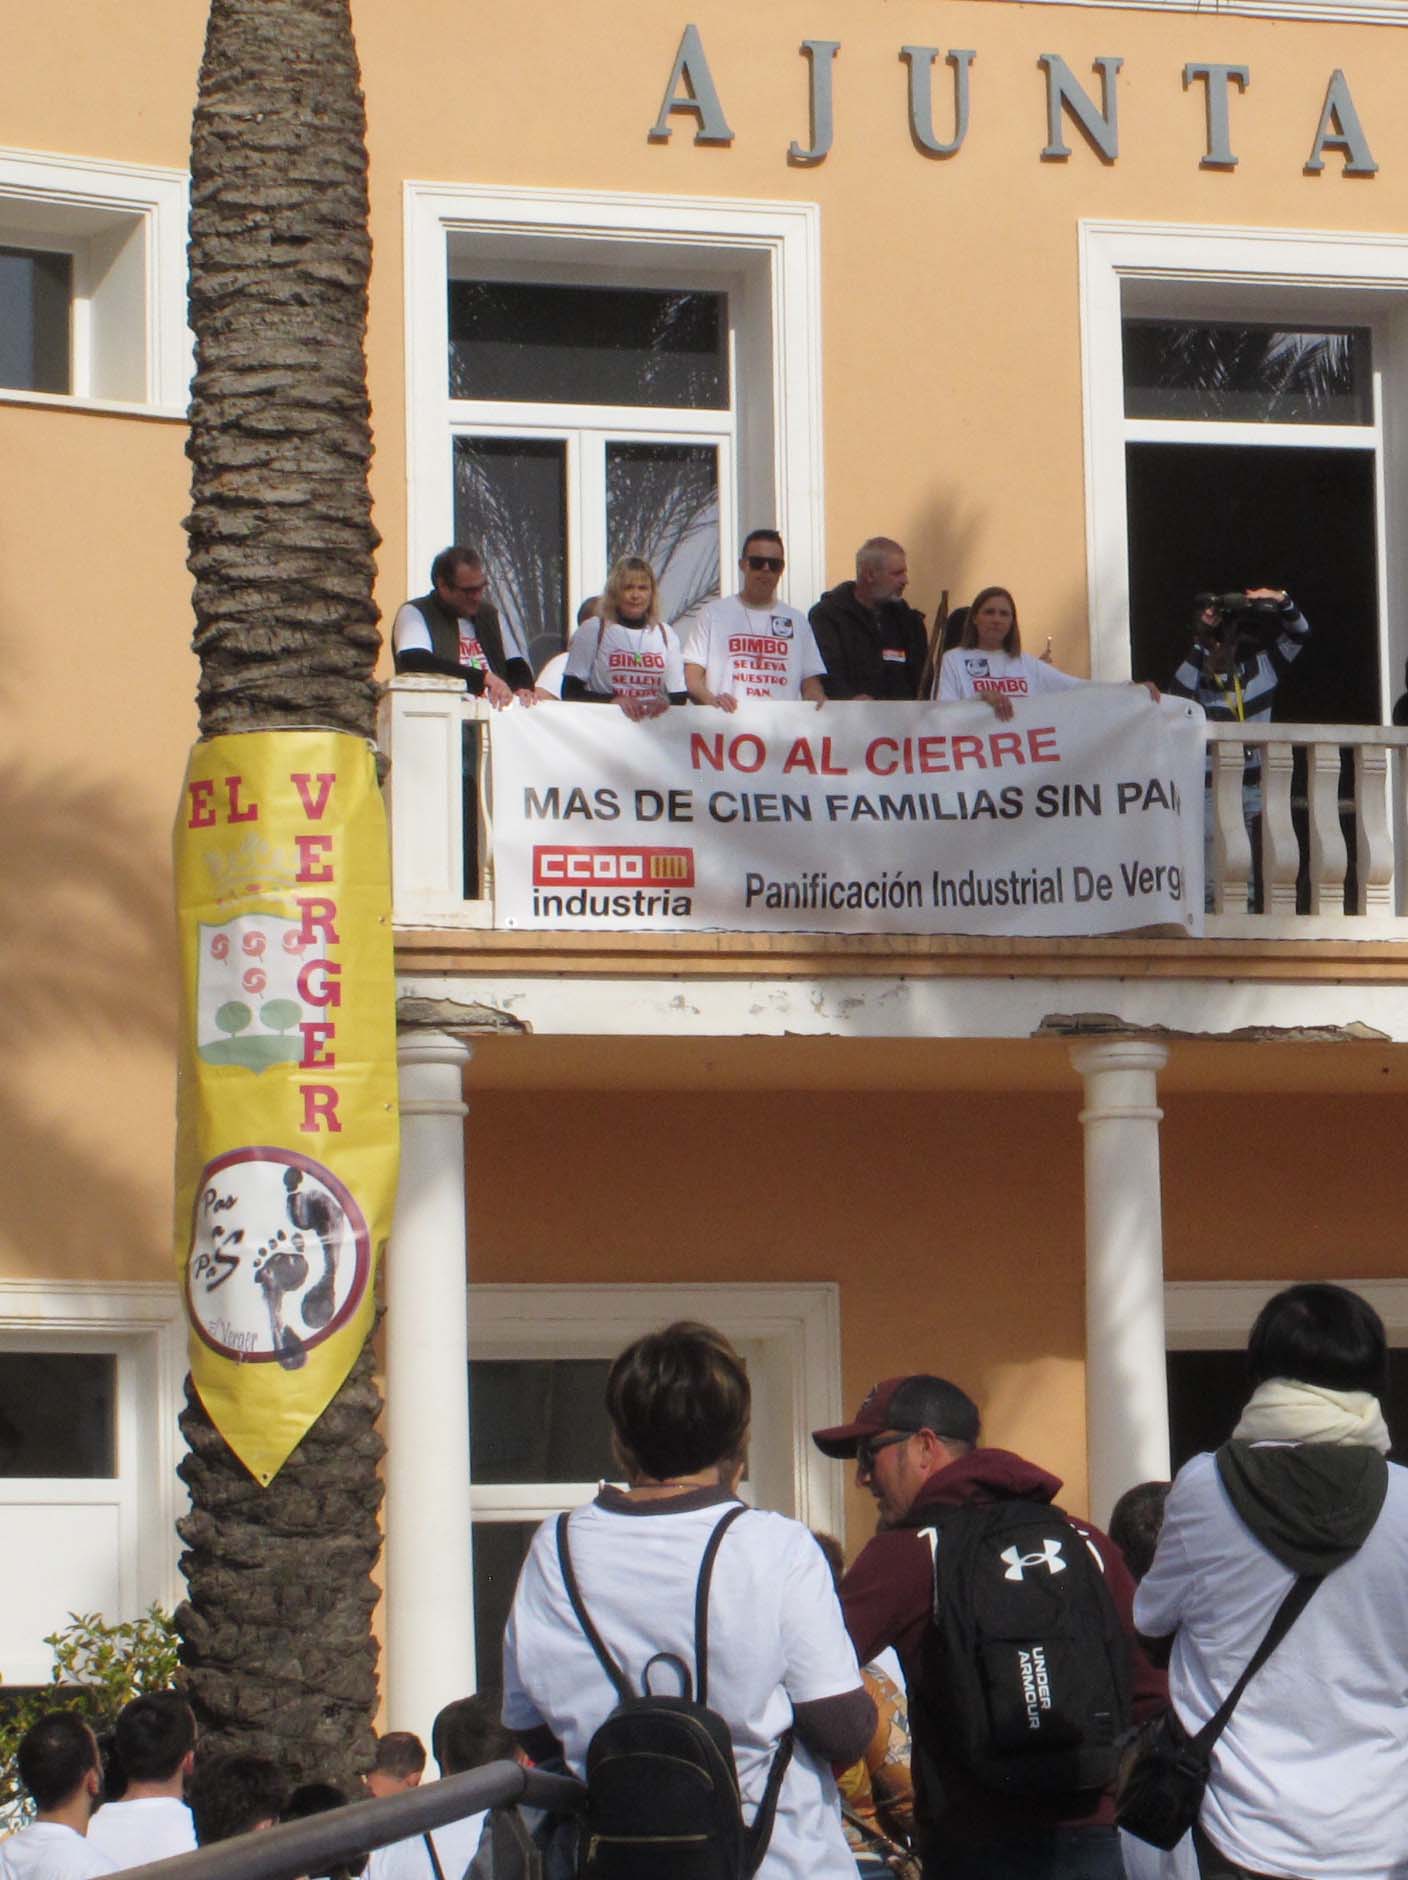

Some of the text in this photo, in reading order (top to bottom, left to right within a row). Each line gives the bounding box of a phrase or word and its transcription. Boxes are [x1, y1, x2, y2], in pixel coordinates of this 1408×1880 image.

[728, 638, 788, 656] BIMBO
[973, 679, 1028, 694] BIMBO
[690, 726, 1061, 777] NO AL CIERRE
[523, 787, 621, 821] MAS
[634, 789, 694, 822] DE
[708, 791, 811, 823] CIEN
[826, 786, 1024, 822] FAMILIAS
[1035, 783, 1102, 817] SIN
[540, 854, 644, 879] CCOO
[744, 860, 1183, 911] Panificación Industrial De Verg
[533, 888, 692, 918] industria
[188, 773, 342, 1132] EL VERGER
[1018, 1650, 1040, 1729] ARMOUR
[1032, 1646, 1051, 1710] UNDER
